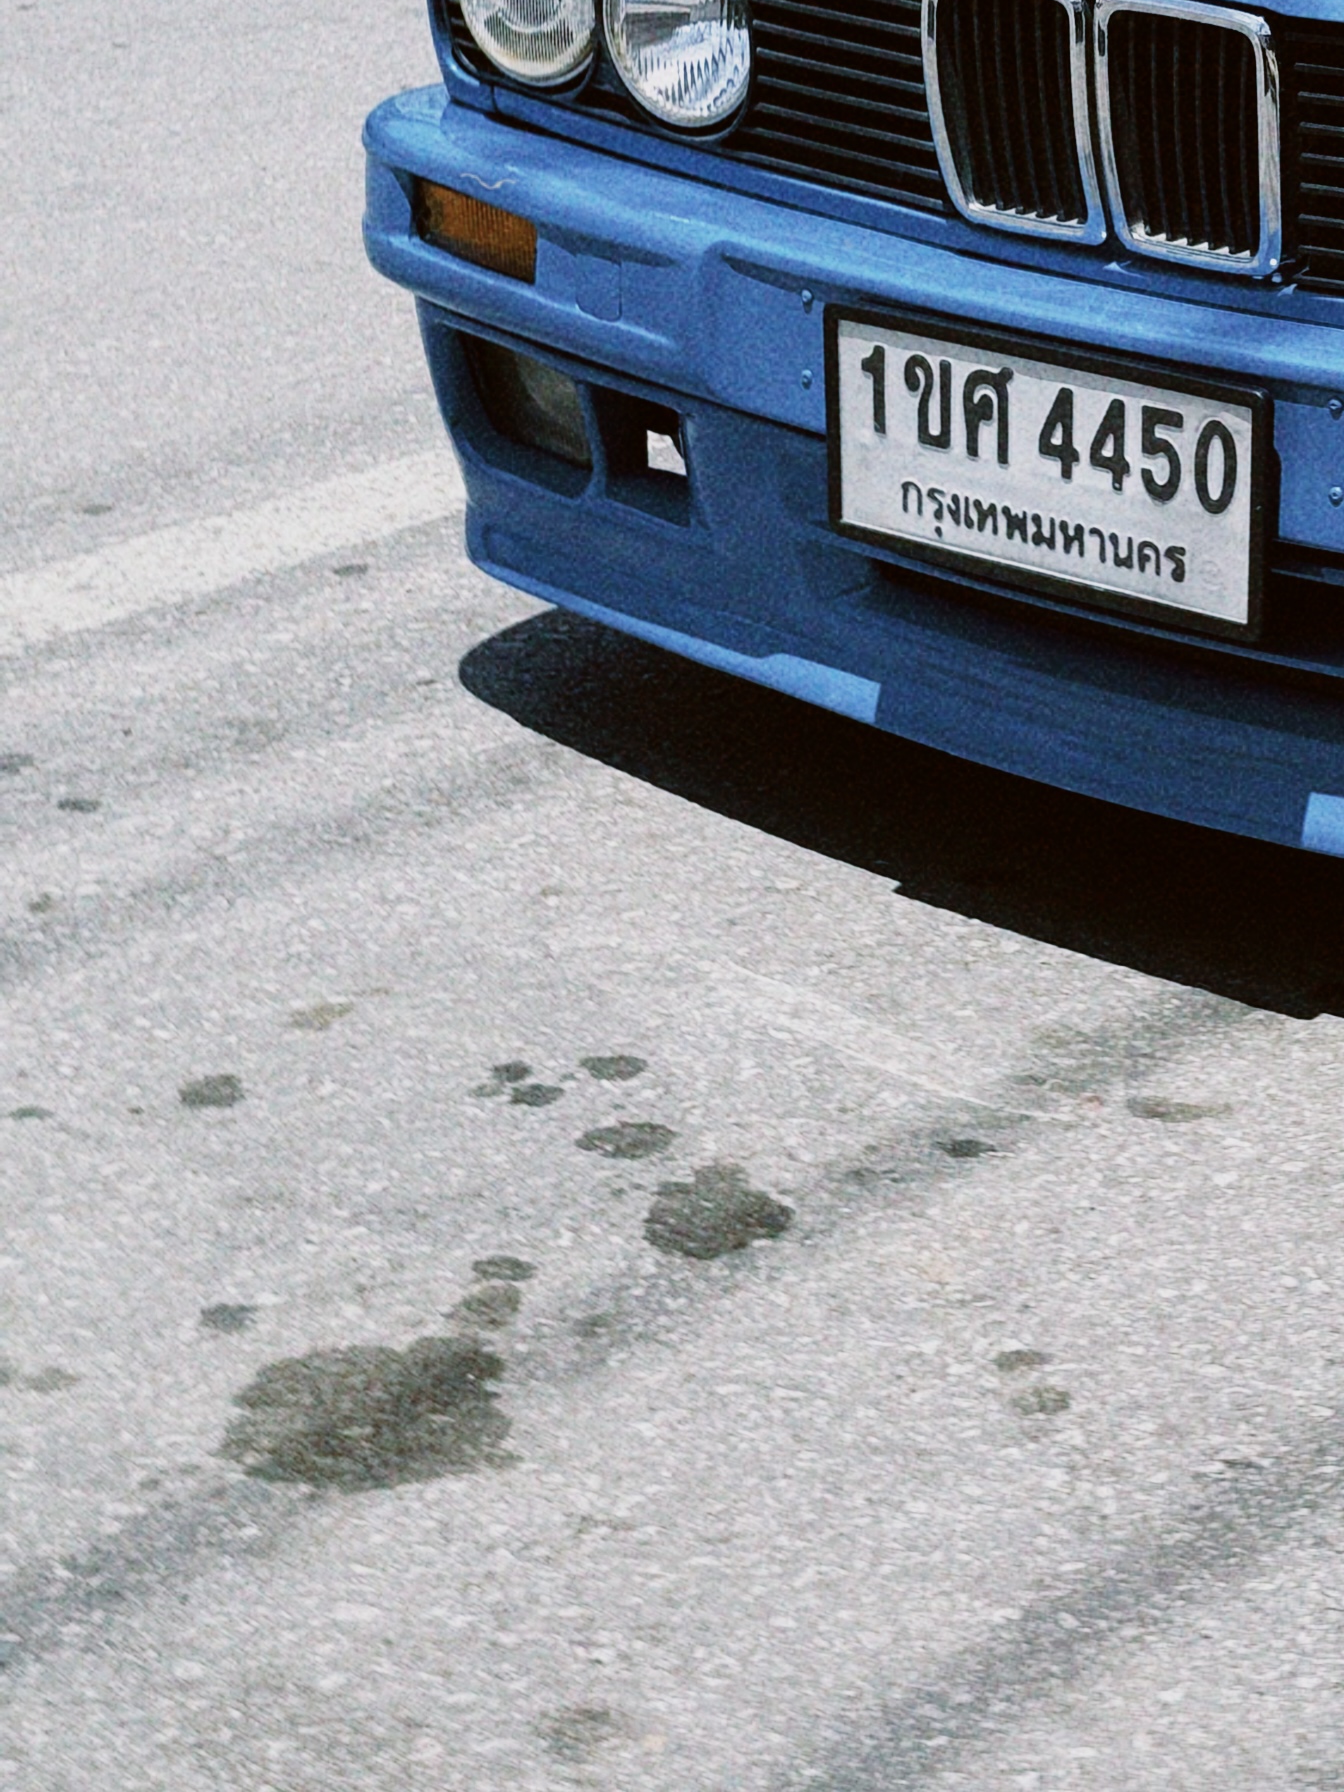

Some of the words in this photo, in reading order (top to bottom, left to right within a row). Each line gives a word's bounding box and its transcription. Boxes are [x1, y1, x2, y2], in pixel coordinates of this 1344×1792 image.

[861, 345, 1013, 468] 1ขศ
[1038, 386, 1238, 515] 4450
[901, 480, 1187, 583] กรุงเทพมหานคร
